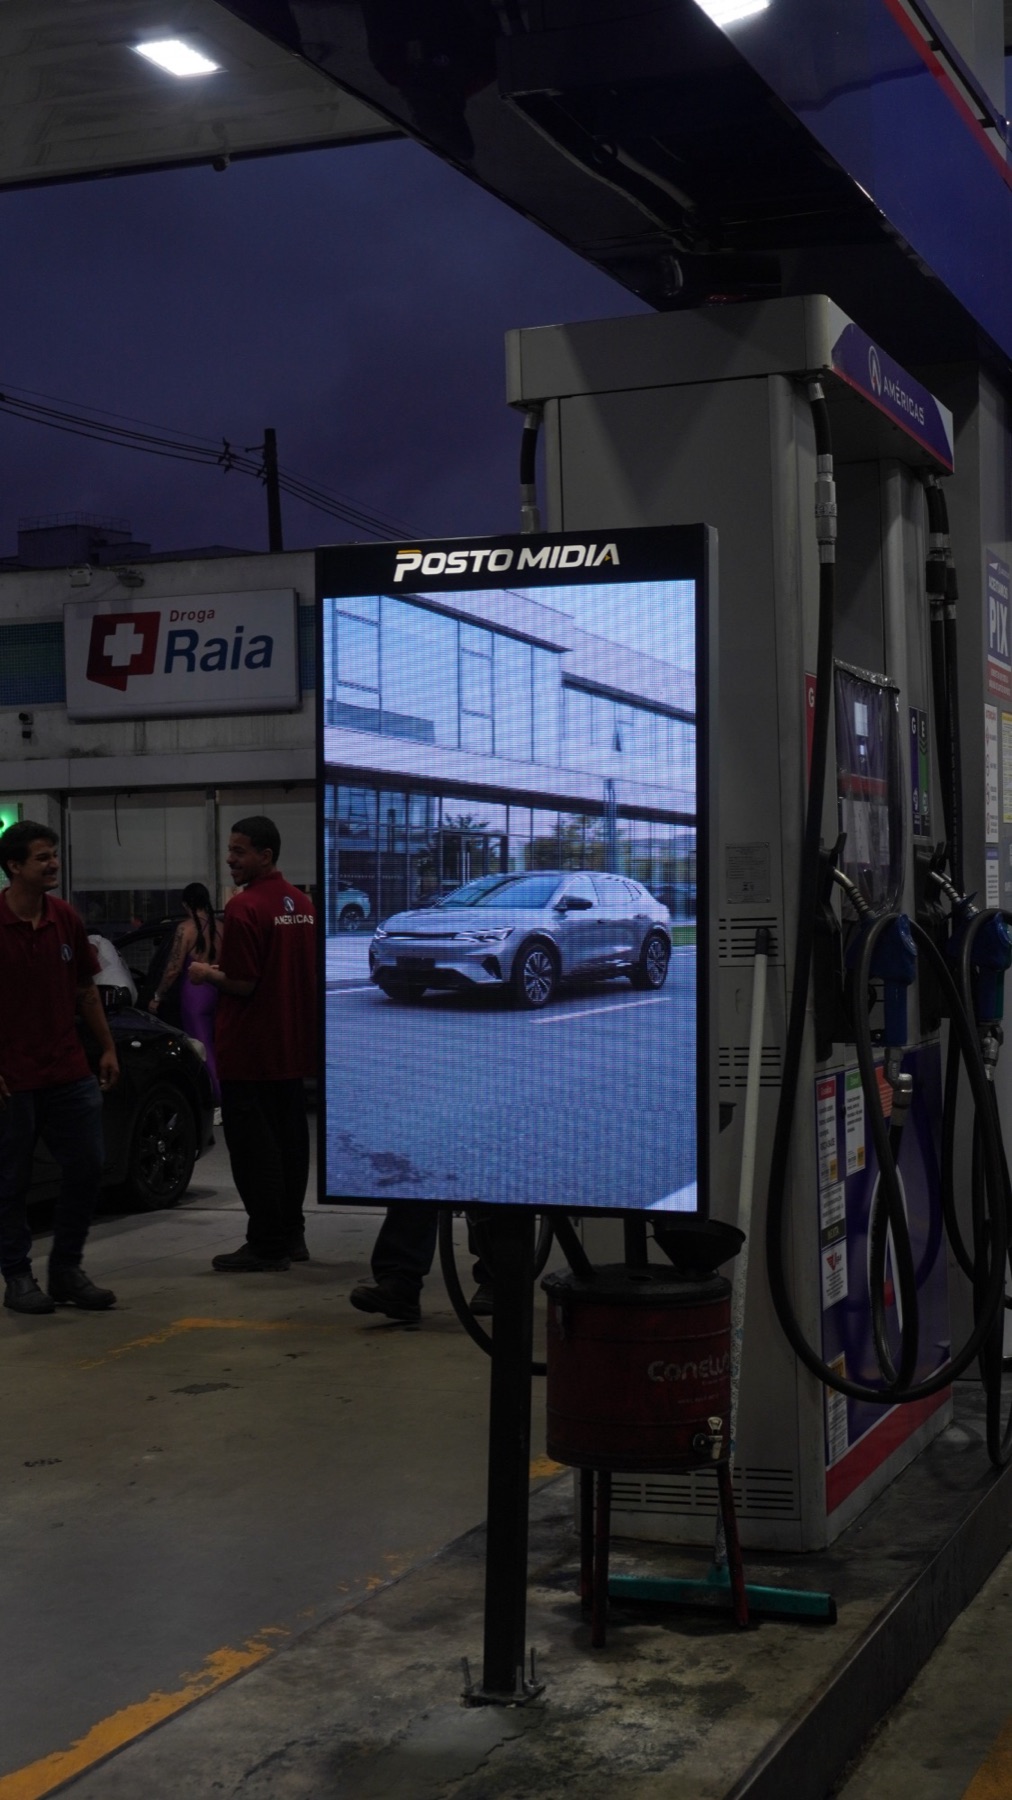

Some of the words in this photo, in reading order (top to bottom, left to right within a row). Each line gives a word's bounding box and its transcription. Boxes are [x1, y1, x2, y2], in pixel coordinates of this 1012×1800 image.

[884, 376, 924, 426] AMÉRICAS
[393, 548, 514, 582] POSTO
[517, 543, 621, 570] MIDIA
[169, 609, 215, 623] Droga
[989, 595, 1008, 657] PIX
[164, 625, 273, 674] Raia
[808, 686, 815, 708] G
[911, 716, 917, 735] G
[921, 720, 926, 738] E
